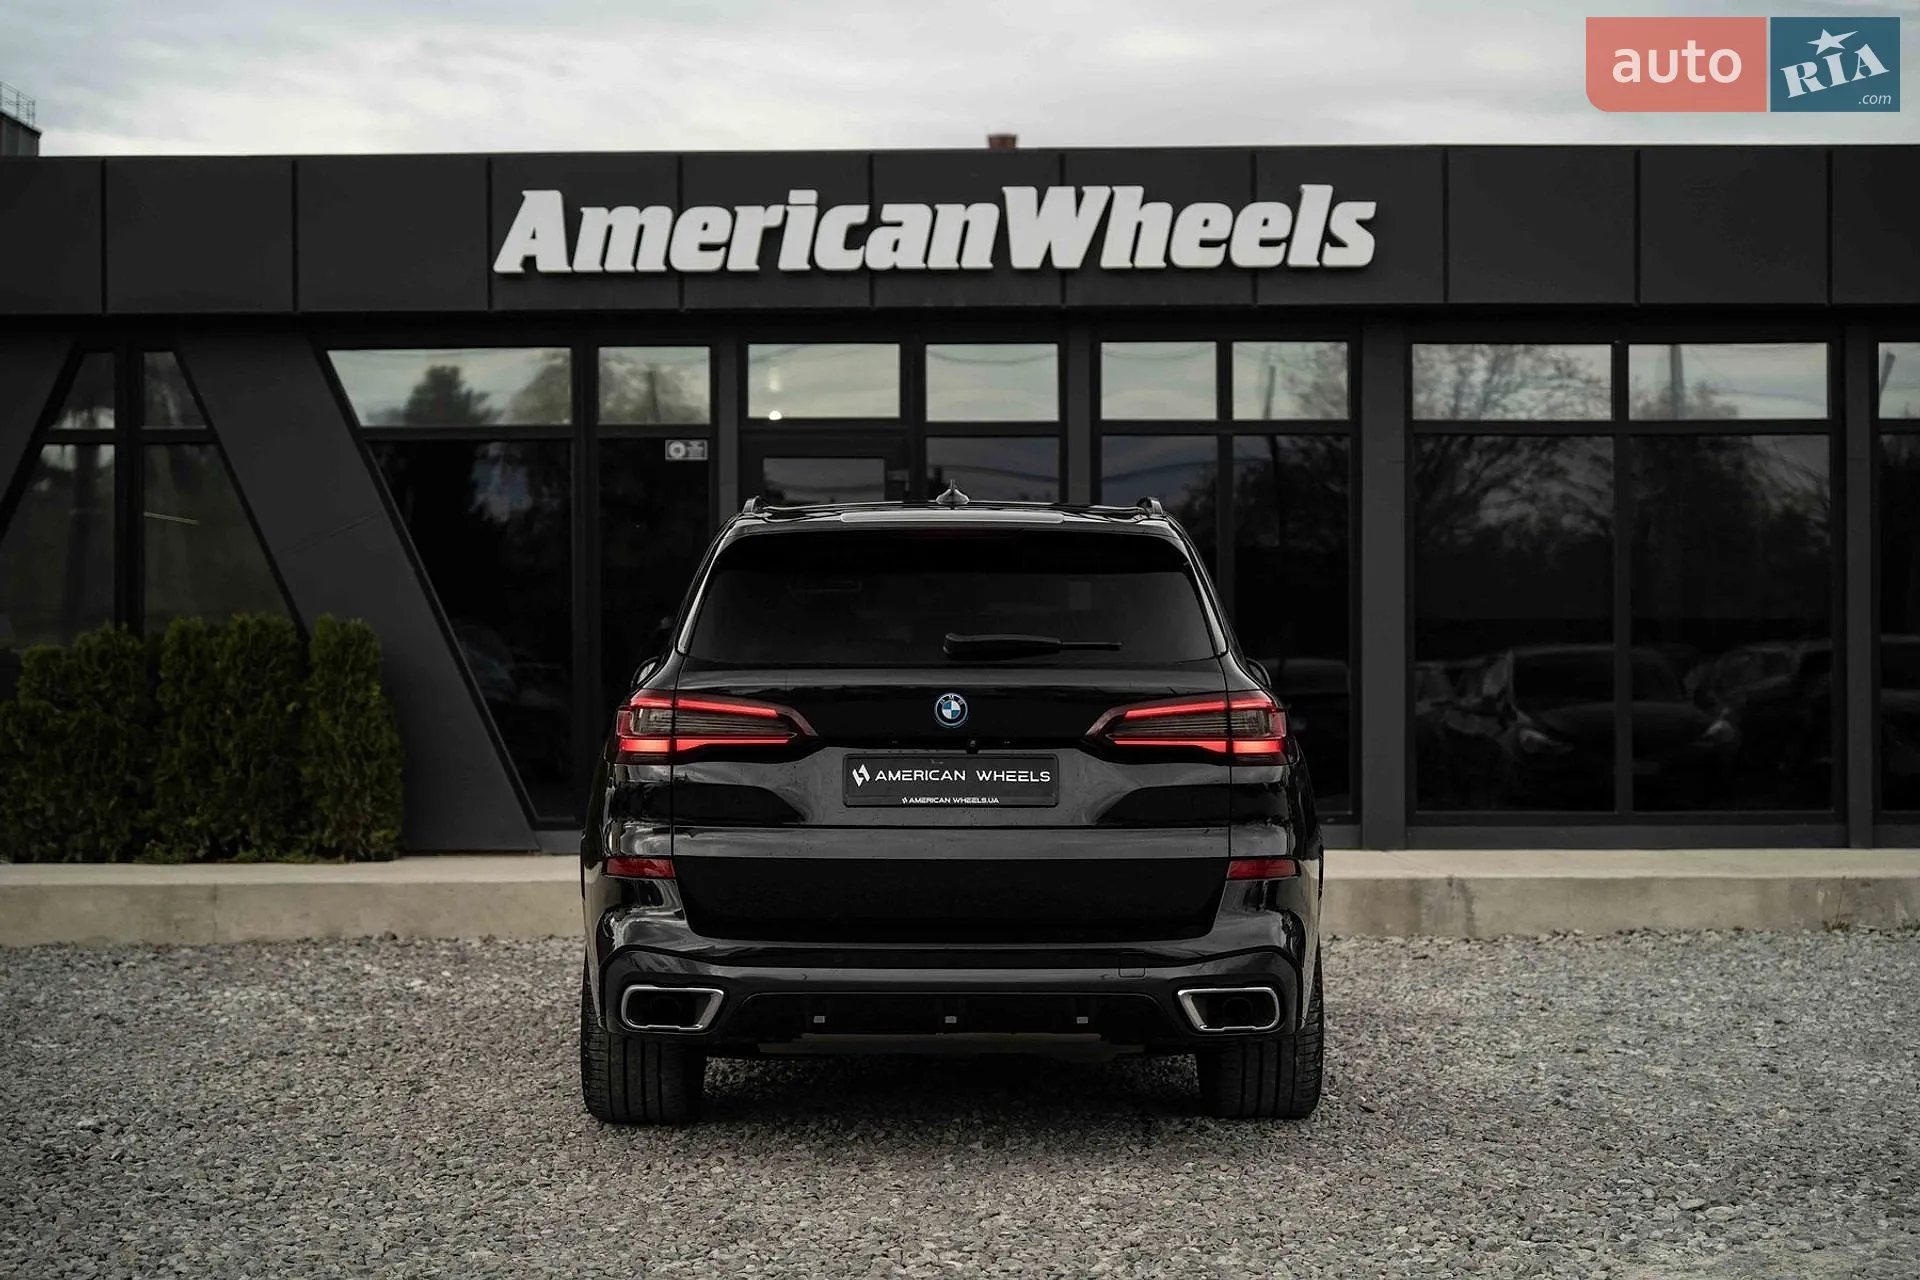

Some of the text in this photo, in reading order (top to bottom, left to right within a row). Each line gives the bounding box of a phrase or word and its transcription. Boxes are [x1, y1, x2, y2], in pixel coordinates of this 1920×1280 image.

[493, 184, 1377, 273] AmericanWheels
[874, 769, 1051, 783] AMERICAN WHEELS
